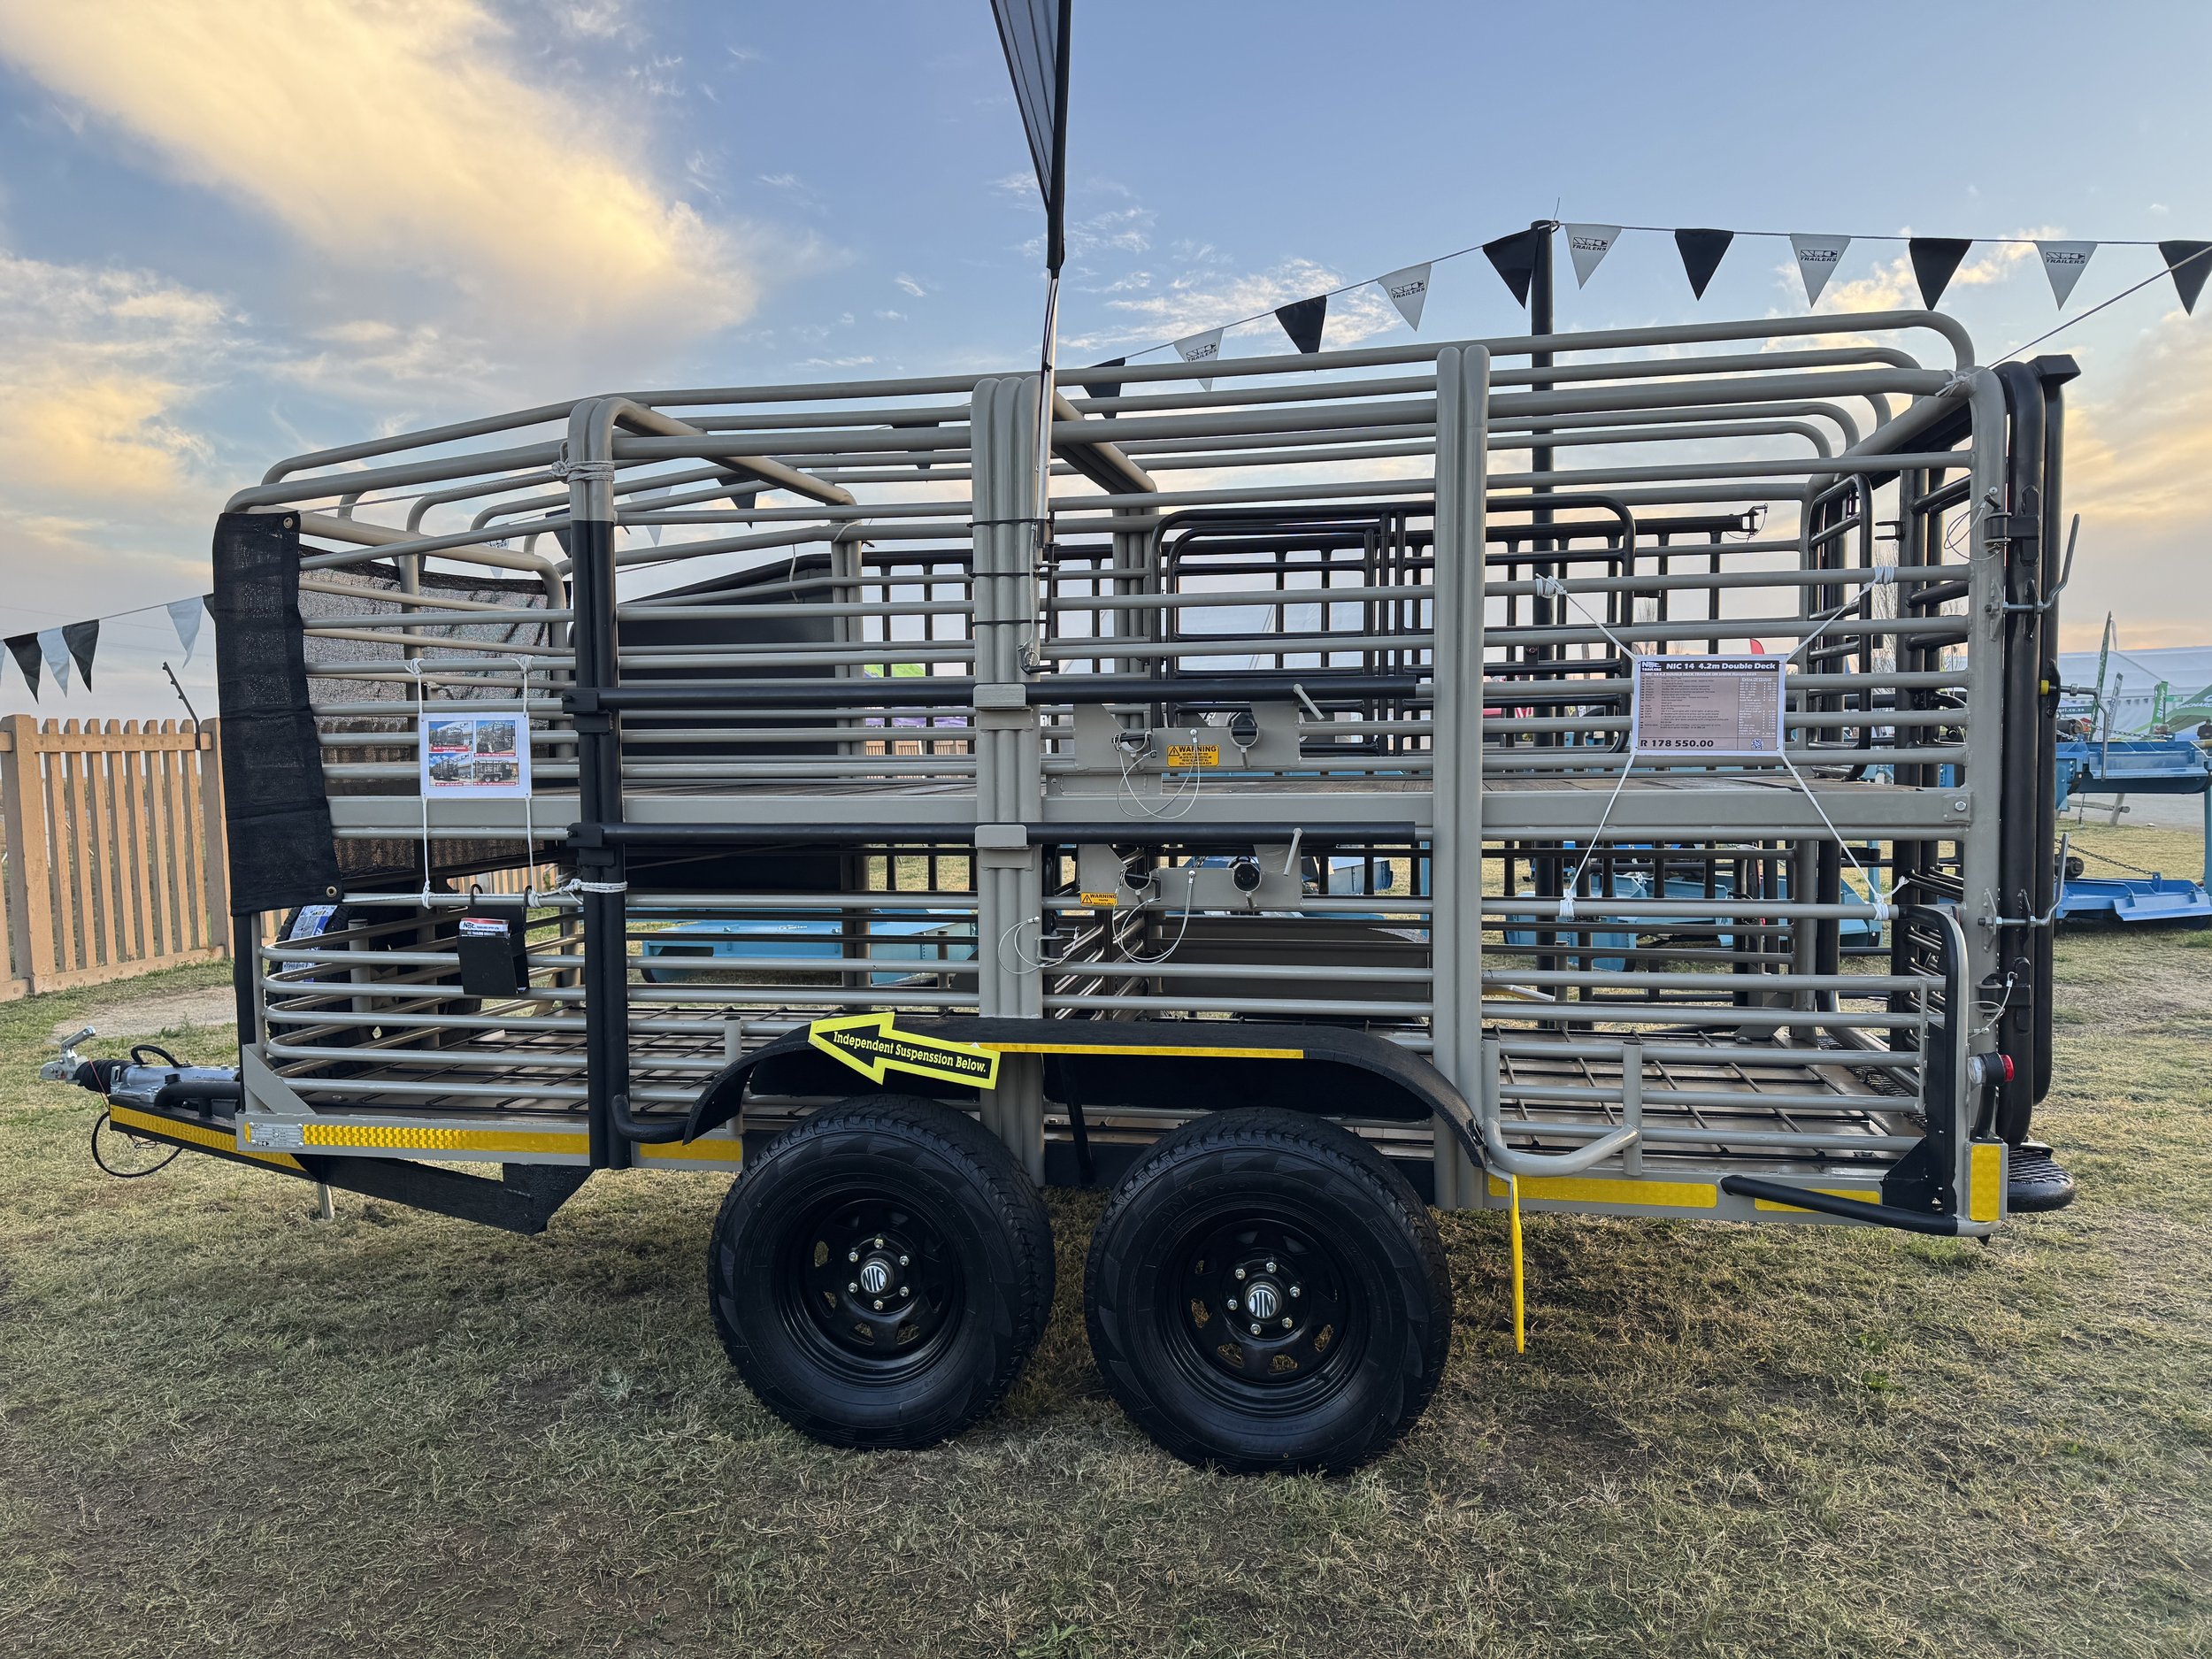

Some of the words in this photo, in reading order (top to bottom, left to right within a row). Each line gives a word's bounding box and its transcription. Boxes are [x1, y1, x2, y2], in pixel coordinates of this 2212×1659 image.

[1393, 288, 1425, 299] TRAILERS
[1187, 349, 1217, 362] TRAILERS
[833, 1031, 895, 1055] Independent
[895, 1044, 954, 1067] Suspenssion
[956, 1056, 987, 1073] Below.
